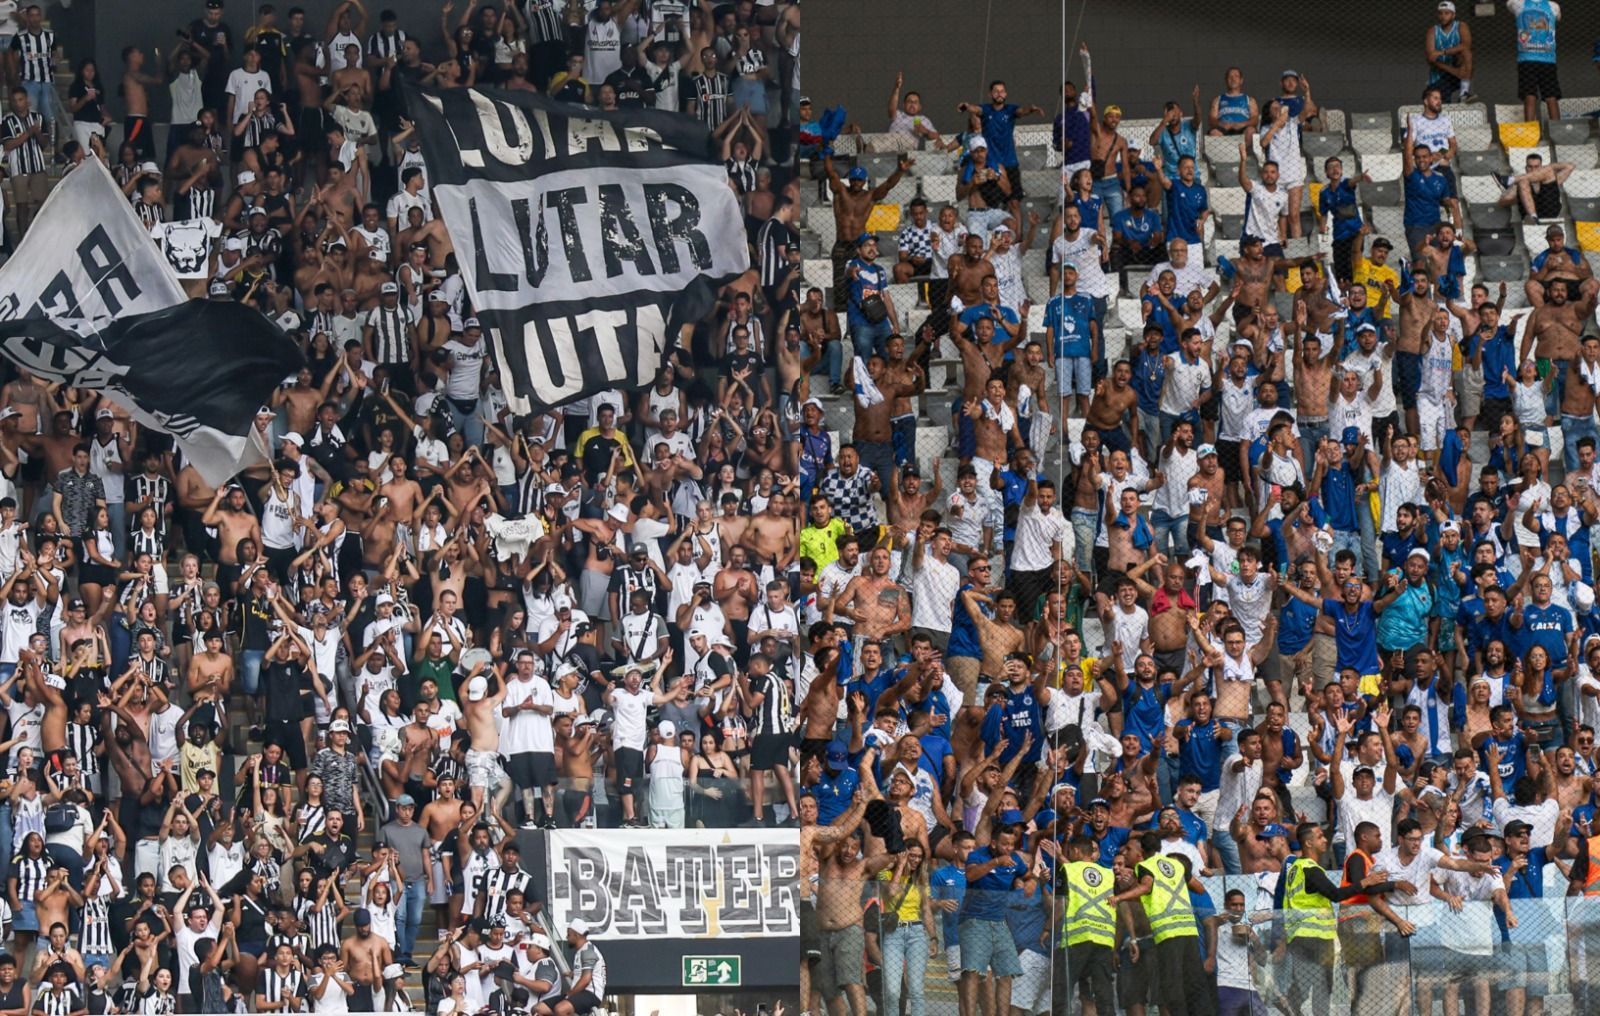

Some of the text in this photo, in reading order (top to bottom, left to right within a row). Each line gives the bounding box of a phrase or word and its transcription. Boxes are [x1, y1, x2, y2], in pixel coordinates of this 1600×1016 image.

[469, 183, 713, 292] LUTAR
[490, 303, 674, 416] LUTA
[820, 542, 826, 554] 9
[1530, 622, 1561, 631] CAIXA
[563, 844, 800, 934] BATER
